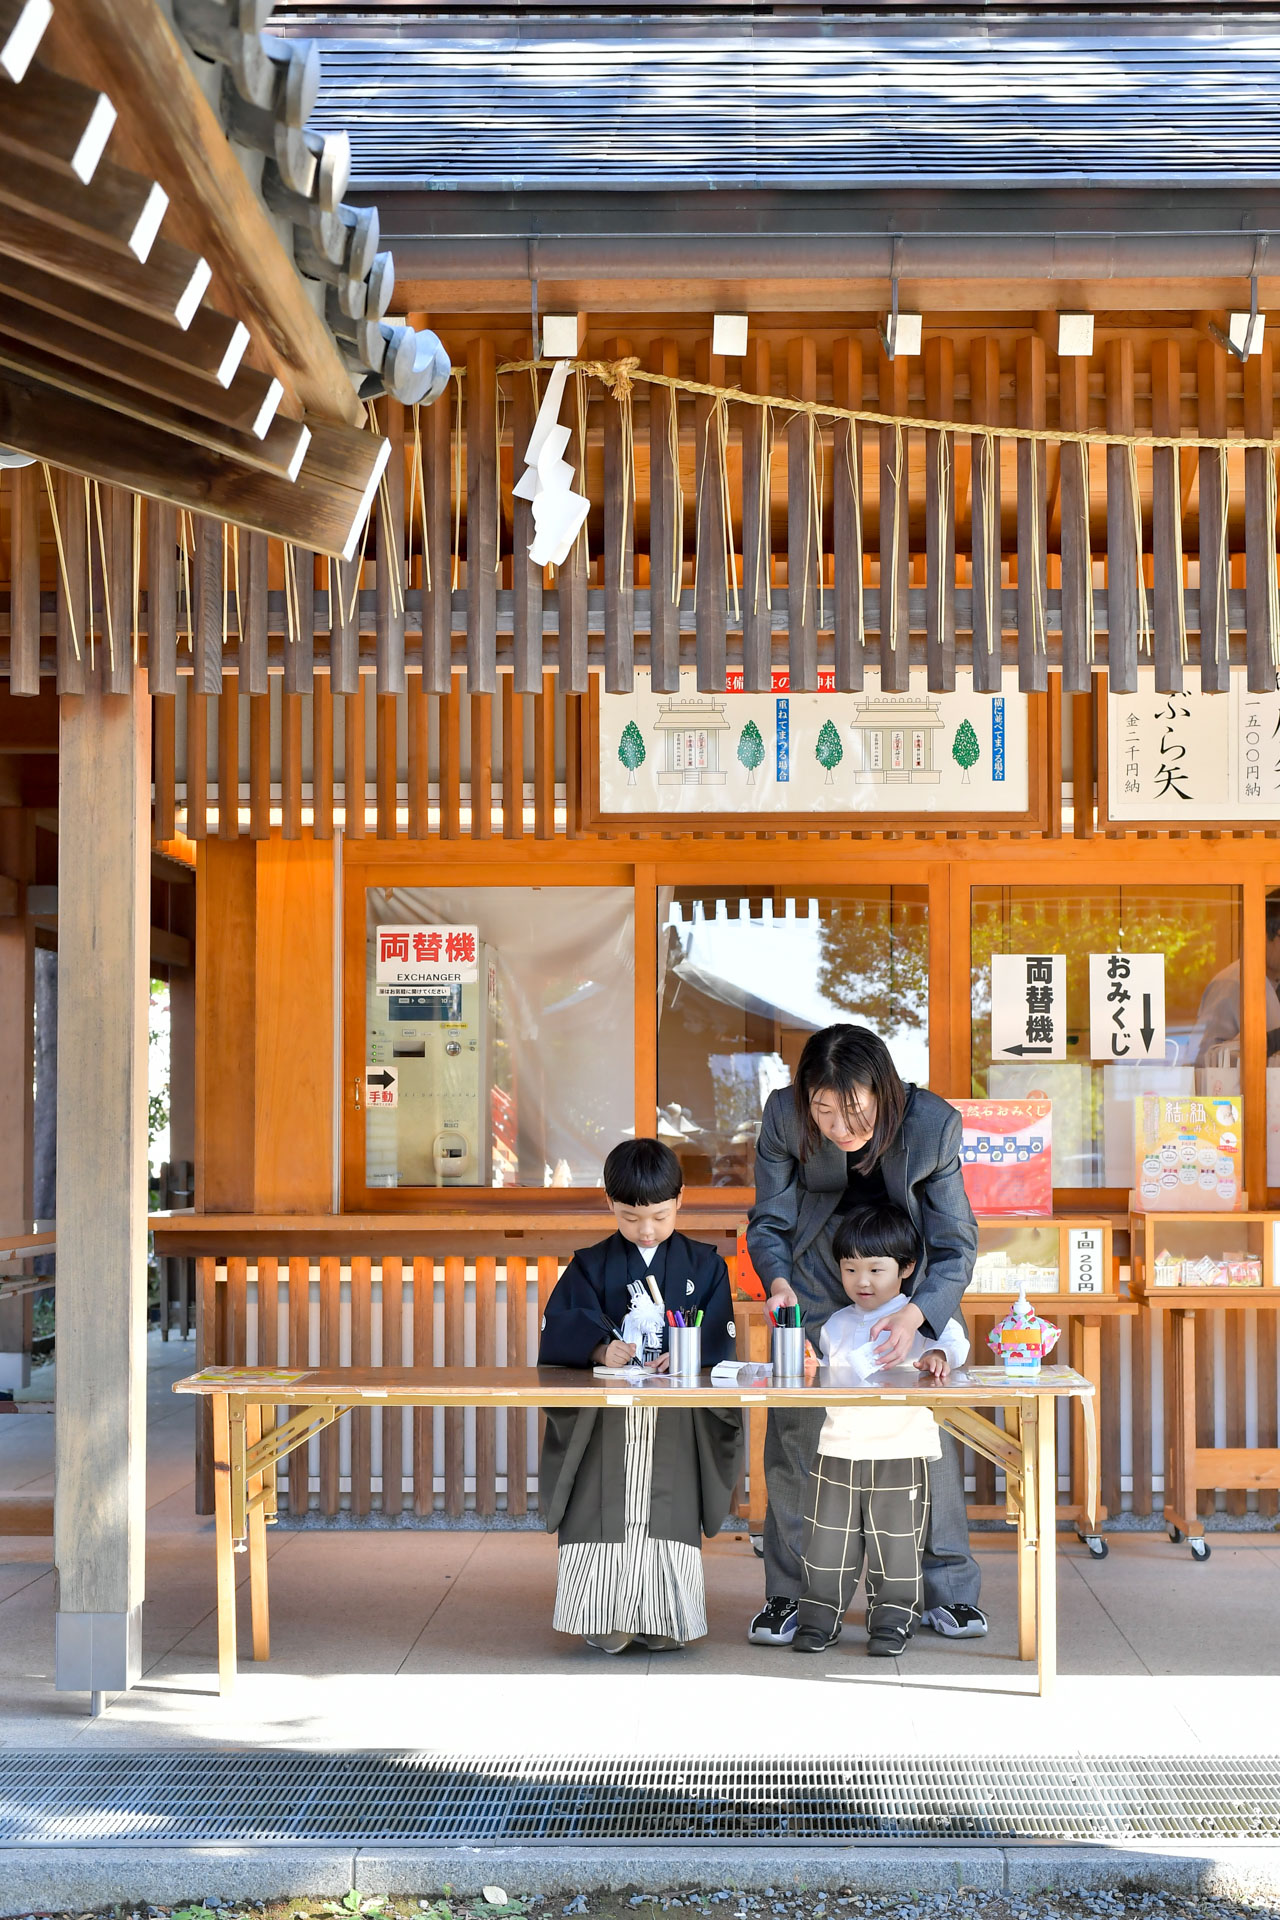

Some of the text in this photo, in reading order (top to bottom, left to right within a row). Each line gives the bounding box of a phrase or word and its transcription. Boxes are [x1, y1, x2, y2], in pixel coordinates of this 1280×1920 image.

[778, 700, 788, 780] 重ねてまつる場合
[1124, 712, 1140, 793] 金二千円納
[1244, 701, 1261, 797] 一五〇〇円納
[380, 932, 475, 962] 両替機
[397, 973, 461, 981] EXCHANGER
[1026, 957, 1054, 1043] 両替機
[1107, 955, 1131, 1056] おみくじ
[369, 1090, 393, 1102] 手動
